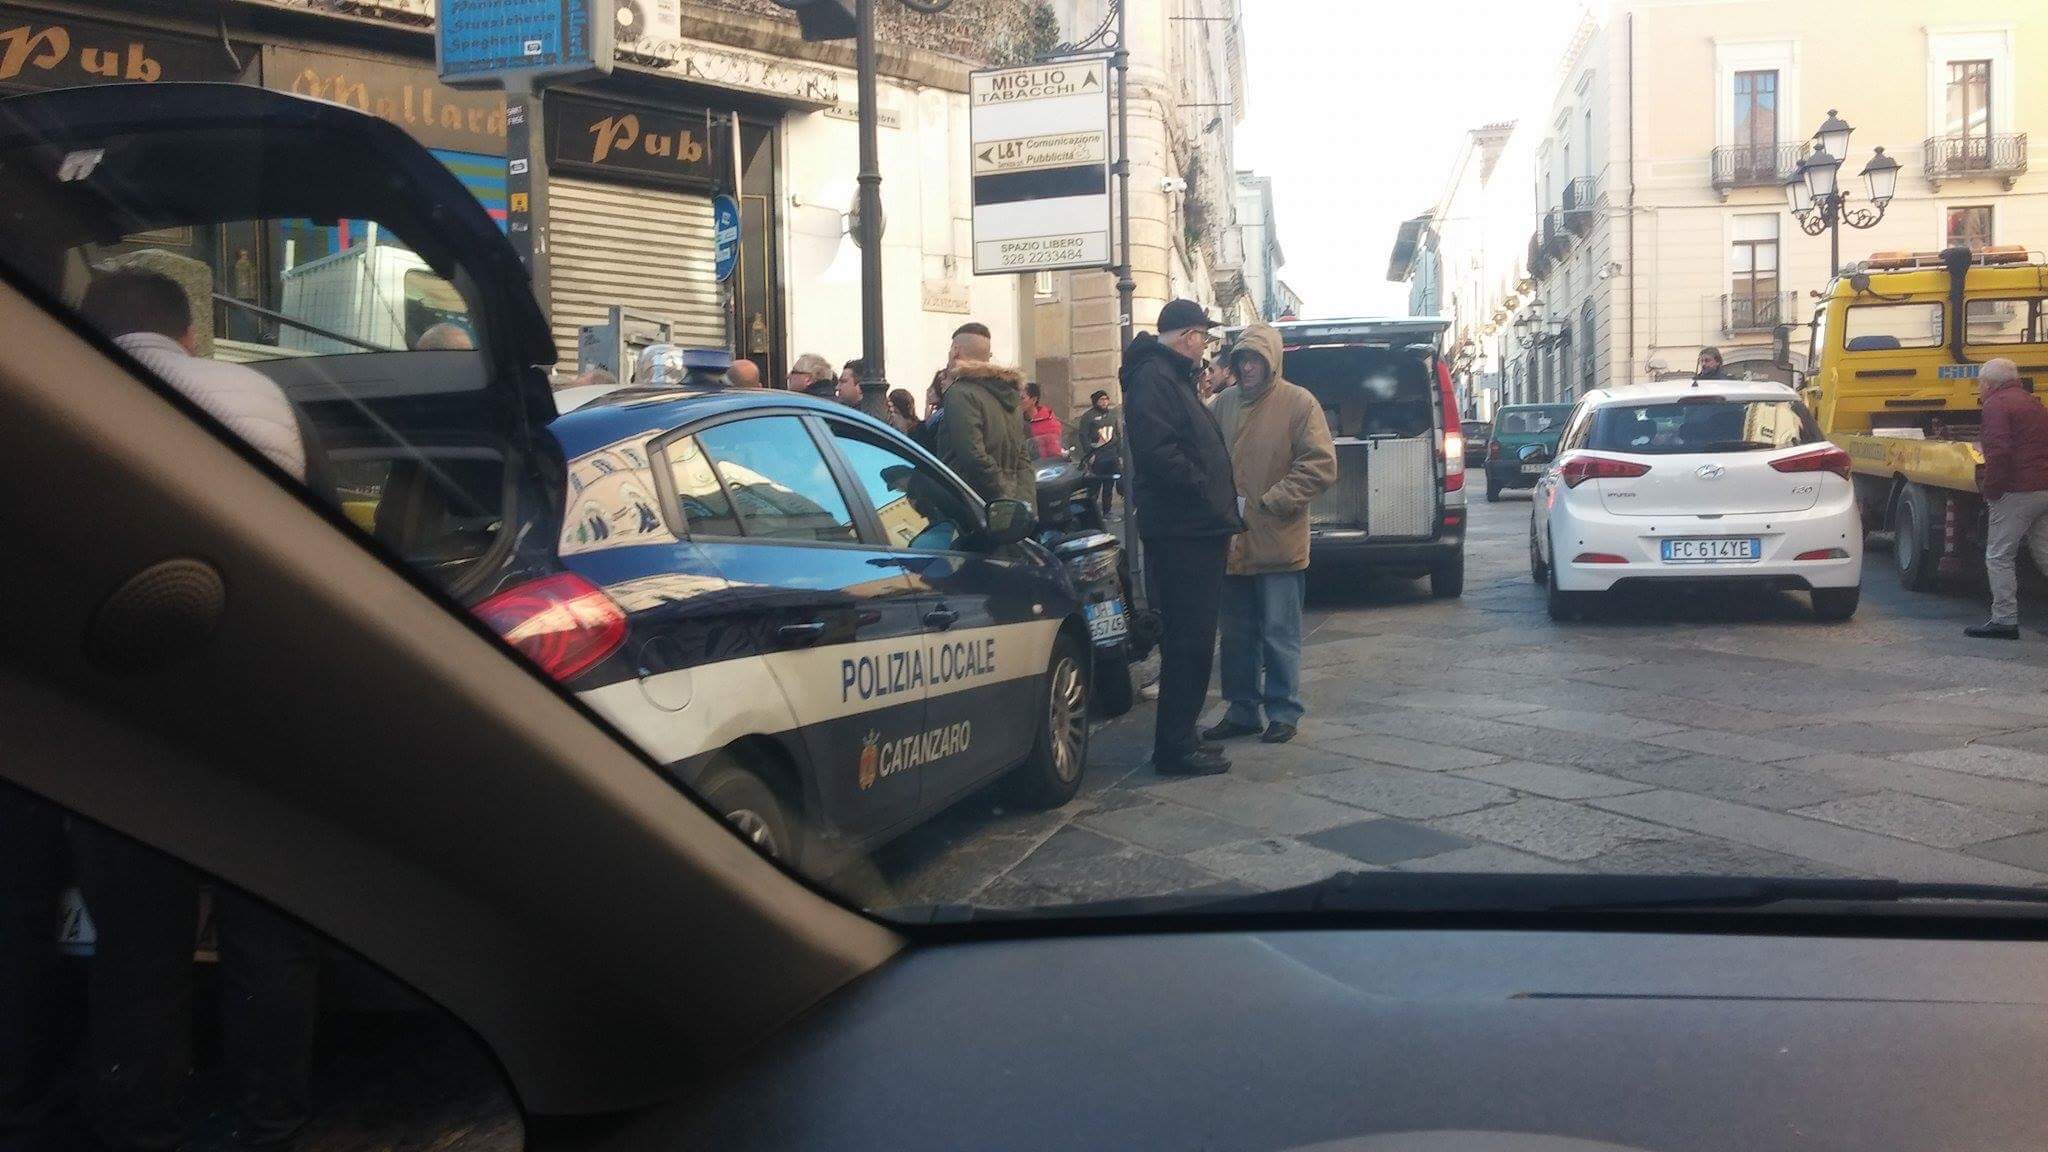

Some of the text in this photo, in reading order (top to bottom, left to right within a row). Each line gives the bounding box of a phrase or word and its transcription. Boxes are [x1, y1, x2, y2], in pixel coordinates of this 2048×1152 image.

[0, 25, 162, 82] Pub
[992, 70, 1065, 91] MIGLIO
[980, 83, 1075, 102] TABACCHI
[589, 113, 703, 164] Pub
[998, 134, 1101, 159] L&T Comunicazione
[1001, 237, 1084, 253] SPAZIO LIBERO
[1002, 253, 1025, 265] 328
[1673, 541, 1749, 557] FC 614YE
[842, 638, 995, 703] POLIZIA LOCALE
[879, 720, 971, 777] CATANZARO
